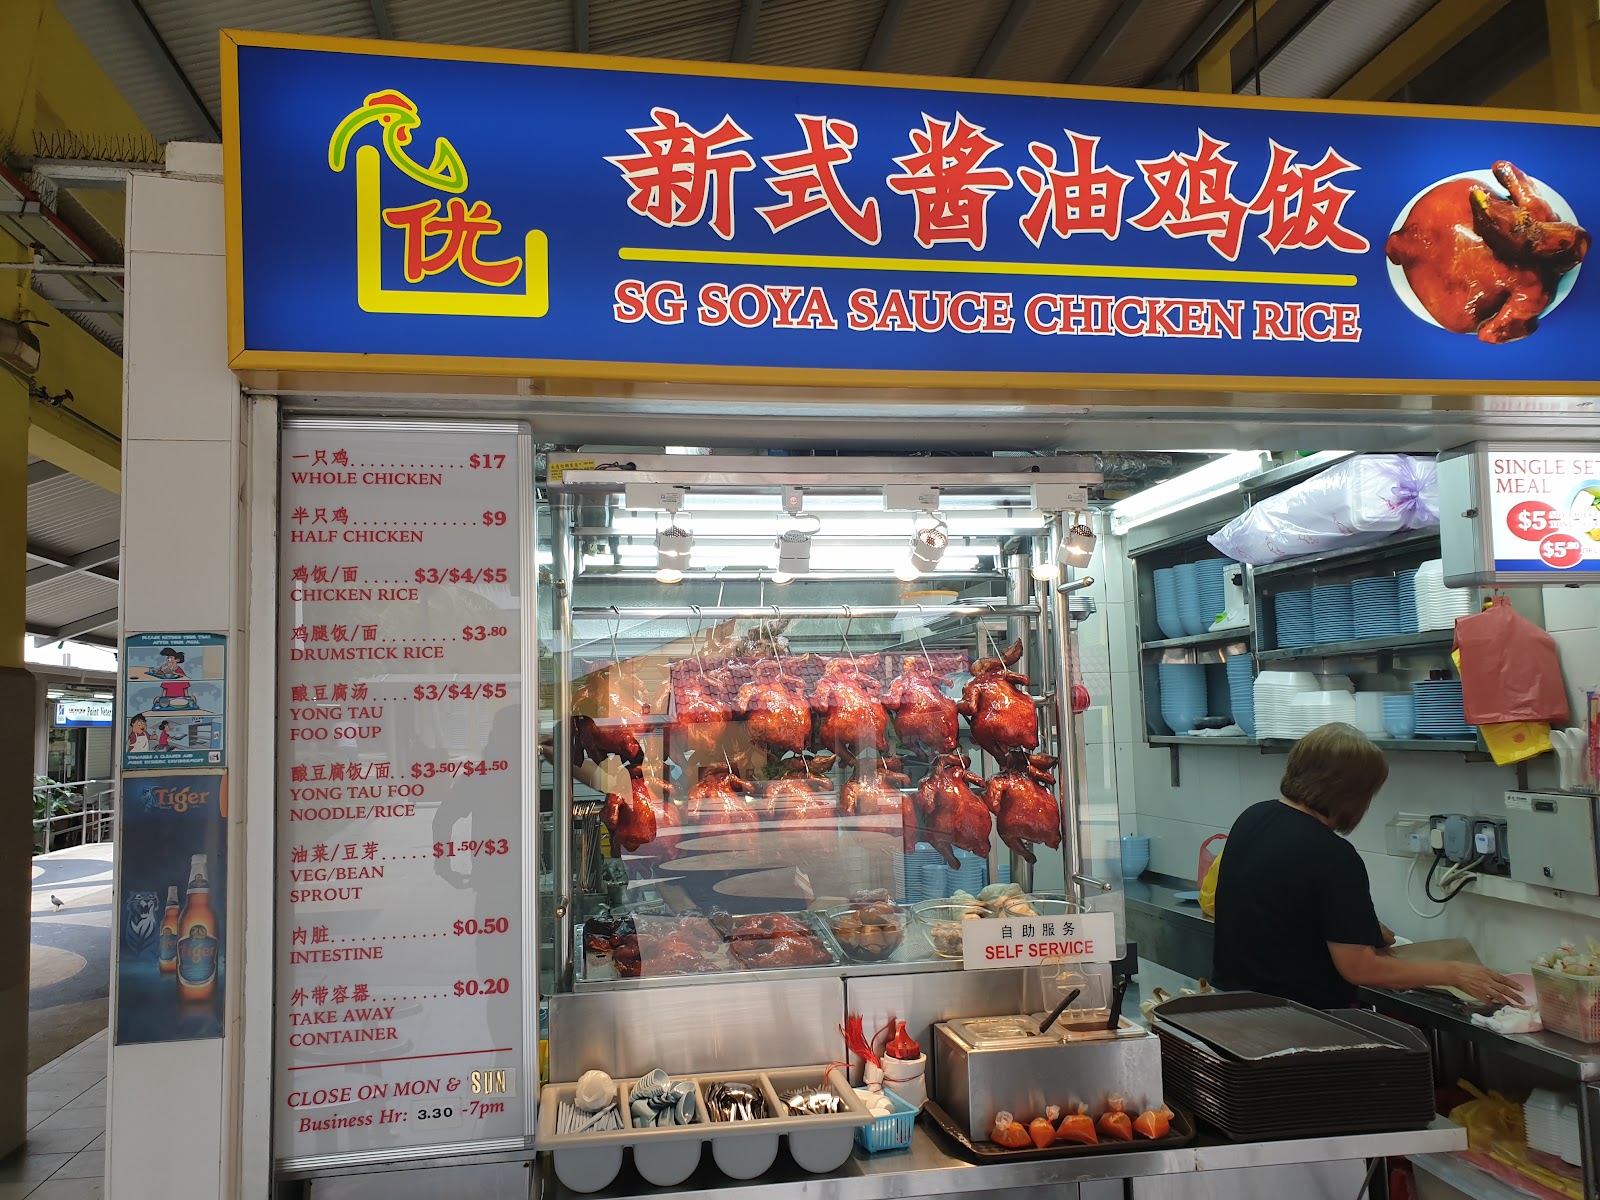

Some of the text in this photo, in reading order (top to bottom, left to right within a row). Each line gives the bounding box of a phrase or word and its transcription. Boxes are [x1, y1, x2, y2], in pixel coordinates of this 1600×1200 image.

[603, 107, 1370, 261] 新式酱油鸡饭
[382, 197, 523, 287] 优
[614, 279, 1362, 342] SG SOYA SAUCE CHICKEN RICE
[292, 448, 506, 470] 一只鸡 $17
[1494, 459, 1565, 475] SINGLE
[292, 471, 443, 486] WHOLE CHICKEN
[1496, 478, 1552, 494] MEAL
[291, 506, 507, 527] 半只鸡 $9
[1518, 509, 1547, 531] $5
[291, 529, 424, 543] HALF CHICKEN
[290, 565, 508, 585] 鸡饭/面 $3/$4/$5
[289, 587, 418, 602] CHICKEN RICE
[291, 624, 508, 643] 鸡腿饭/面 $3.80
[289, 645, 445, 662] DRUMSTICK RICE
[413, 682, 508, 702] $3/$4/$5
[290, 706, 384, 721] YONG TAU
[290, 726, 382, 742] FOO SOUP
[154, 786, 210, 813] Tiger
[290, 784, 426, 802] YONG TAU FOO
[290, 804, 414, 822] NOODLE/RICE
[291, 842, 378, 863] 油菜/豆芽
[290, 866, 384, 882] VEG/BEAN
[290, 887, 362, 903] SPROUT
[291, 917, 510, 945] 内脏 $0.50
[1001, 921, 1075, 939] 自助服务
[290, 946, 383, 965] INTESTINE
[985, 940, 1094, 960] SELF SERVICE
[292, 977, 510, 1006] 外带容器 $0.20
[290, 1007, 394, 1027] TAKE AWAY
[289, 1028, 397, 1047] CONTAINER
[287, 1069, 506, 1108] CLOSE ON MON & SUN
[299, 1099, 505, 1133] Business Hr: 3.30 -7pm
